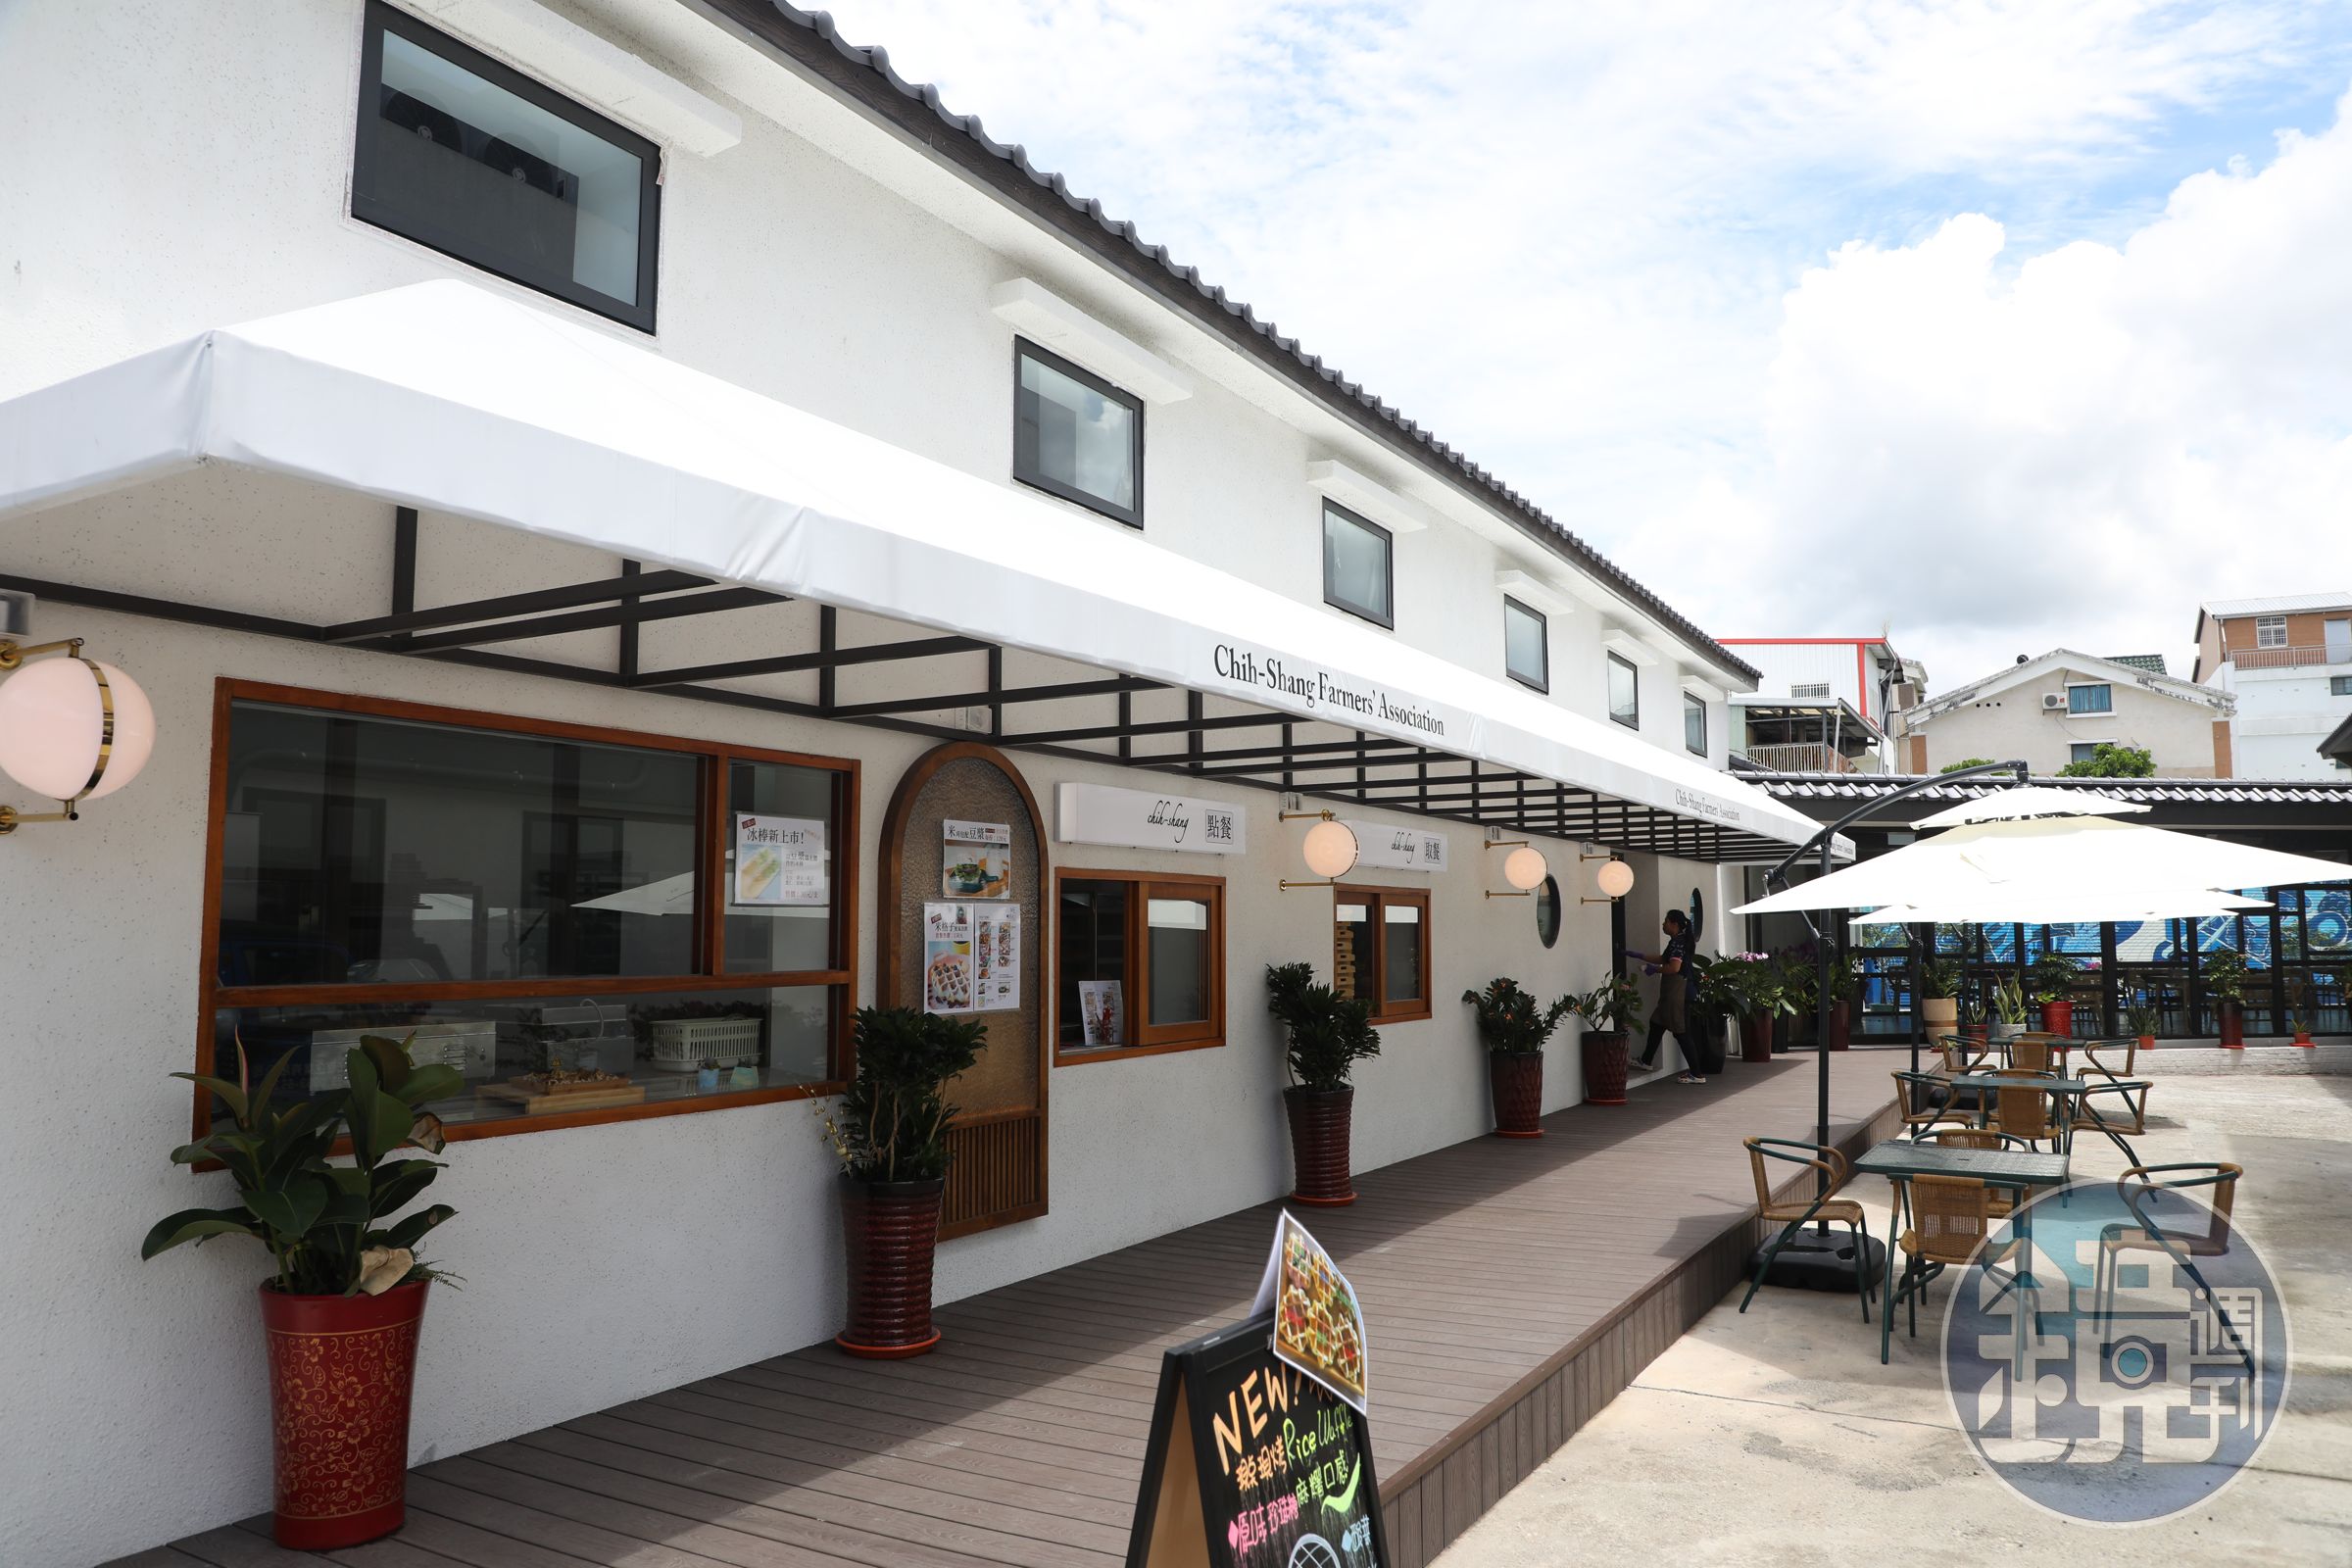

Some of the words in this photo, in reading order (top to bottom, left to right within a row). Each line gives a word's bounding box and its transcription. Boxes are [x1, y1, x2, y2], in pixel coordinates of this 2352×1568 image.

[1214, 644, 1315, 708] Chih-Shang
[1377, 693, 1445, 736] Association
[1675, 788, 1702, 816] Chih-Shang
[1148, 800, 1189, 843] chih-shang
[1206, 814, 1232, 840] 點餐
[1425, 842, 1441, 860] 取餐
[1283, 1417, 1317, 1469] Rice
[1317, 1402, 1353, 1446] Waffle
